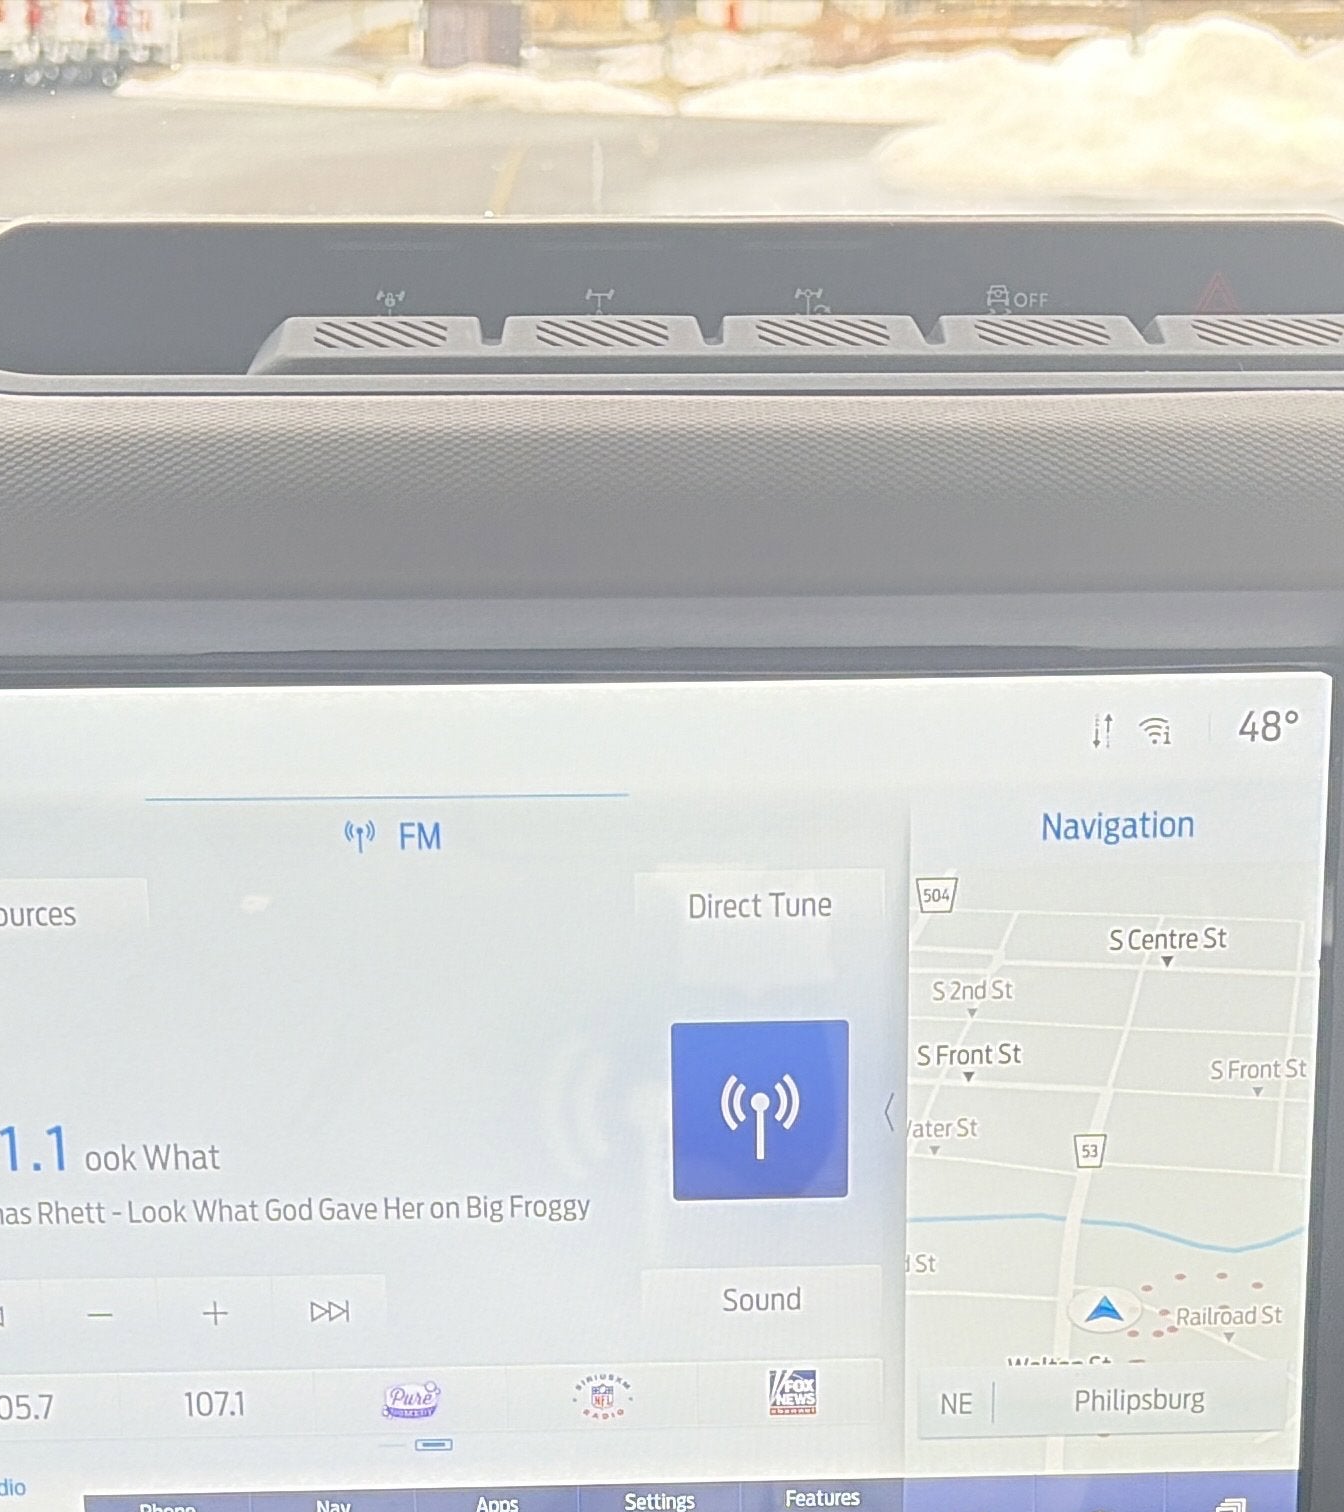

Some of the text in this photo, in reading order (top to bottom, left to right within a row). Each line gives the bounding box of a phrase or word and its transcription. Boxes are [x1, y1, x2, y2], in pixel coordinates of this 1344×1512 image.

[1013, 292, 1049, 308] OFF
[398, 821, 443, 851] FM
[1041, 808, 1196, 847] Navigation
[687, 890, 833, 920] Direct Tune
[922, 887, 951, 904] 504
[1109, 927, 1228, 951] S Centre St
[932, 979, 1014, 1001] S 2nd St
[917, 1043, 1022, 1066] S Front St
[1211, 1058, 1308, 1080] S Front St
[957, 1117, 978, 1137] St
[84, 1144, 137, 1172] ook
[142, 1143, 222, 1171] What
[1082, 1144, 1098, 1160] 53
[38, 1201, 106, 1225] Rhett
[128, 1200, 188, 1224] Look
[192, 1199, 260, 1223] What
[264, 1198, 313, 1221] God
[318, 1198, 379, 1221] Gave
[383, 1197, 425, 1220] Her
[429, 1202, 461, 1219] on
[466, 1196, 504, 1223] Big
[509, 1195, 591, 1221] Froggy
[915, 1253, 936, 1273] St
[722, 1286, 802, 1313] Sound
[1176, 1305, 1284, 1327] Railroad St
[390, 1386, 433, 1406] Pure
[784, 1379, 815, 1393] FOX
[183, 1390, 245, 1417] 107.1
[775, 1392, 816, 1406] NEWS
[940, 1388, 1206, 1415] NE Philipsburg
[624, 1493, 696, 1512] Settings
[785, 1489, 861, 1508] Features
